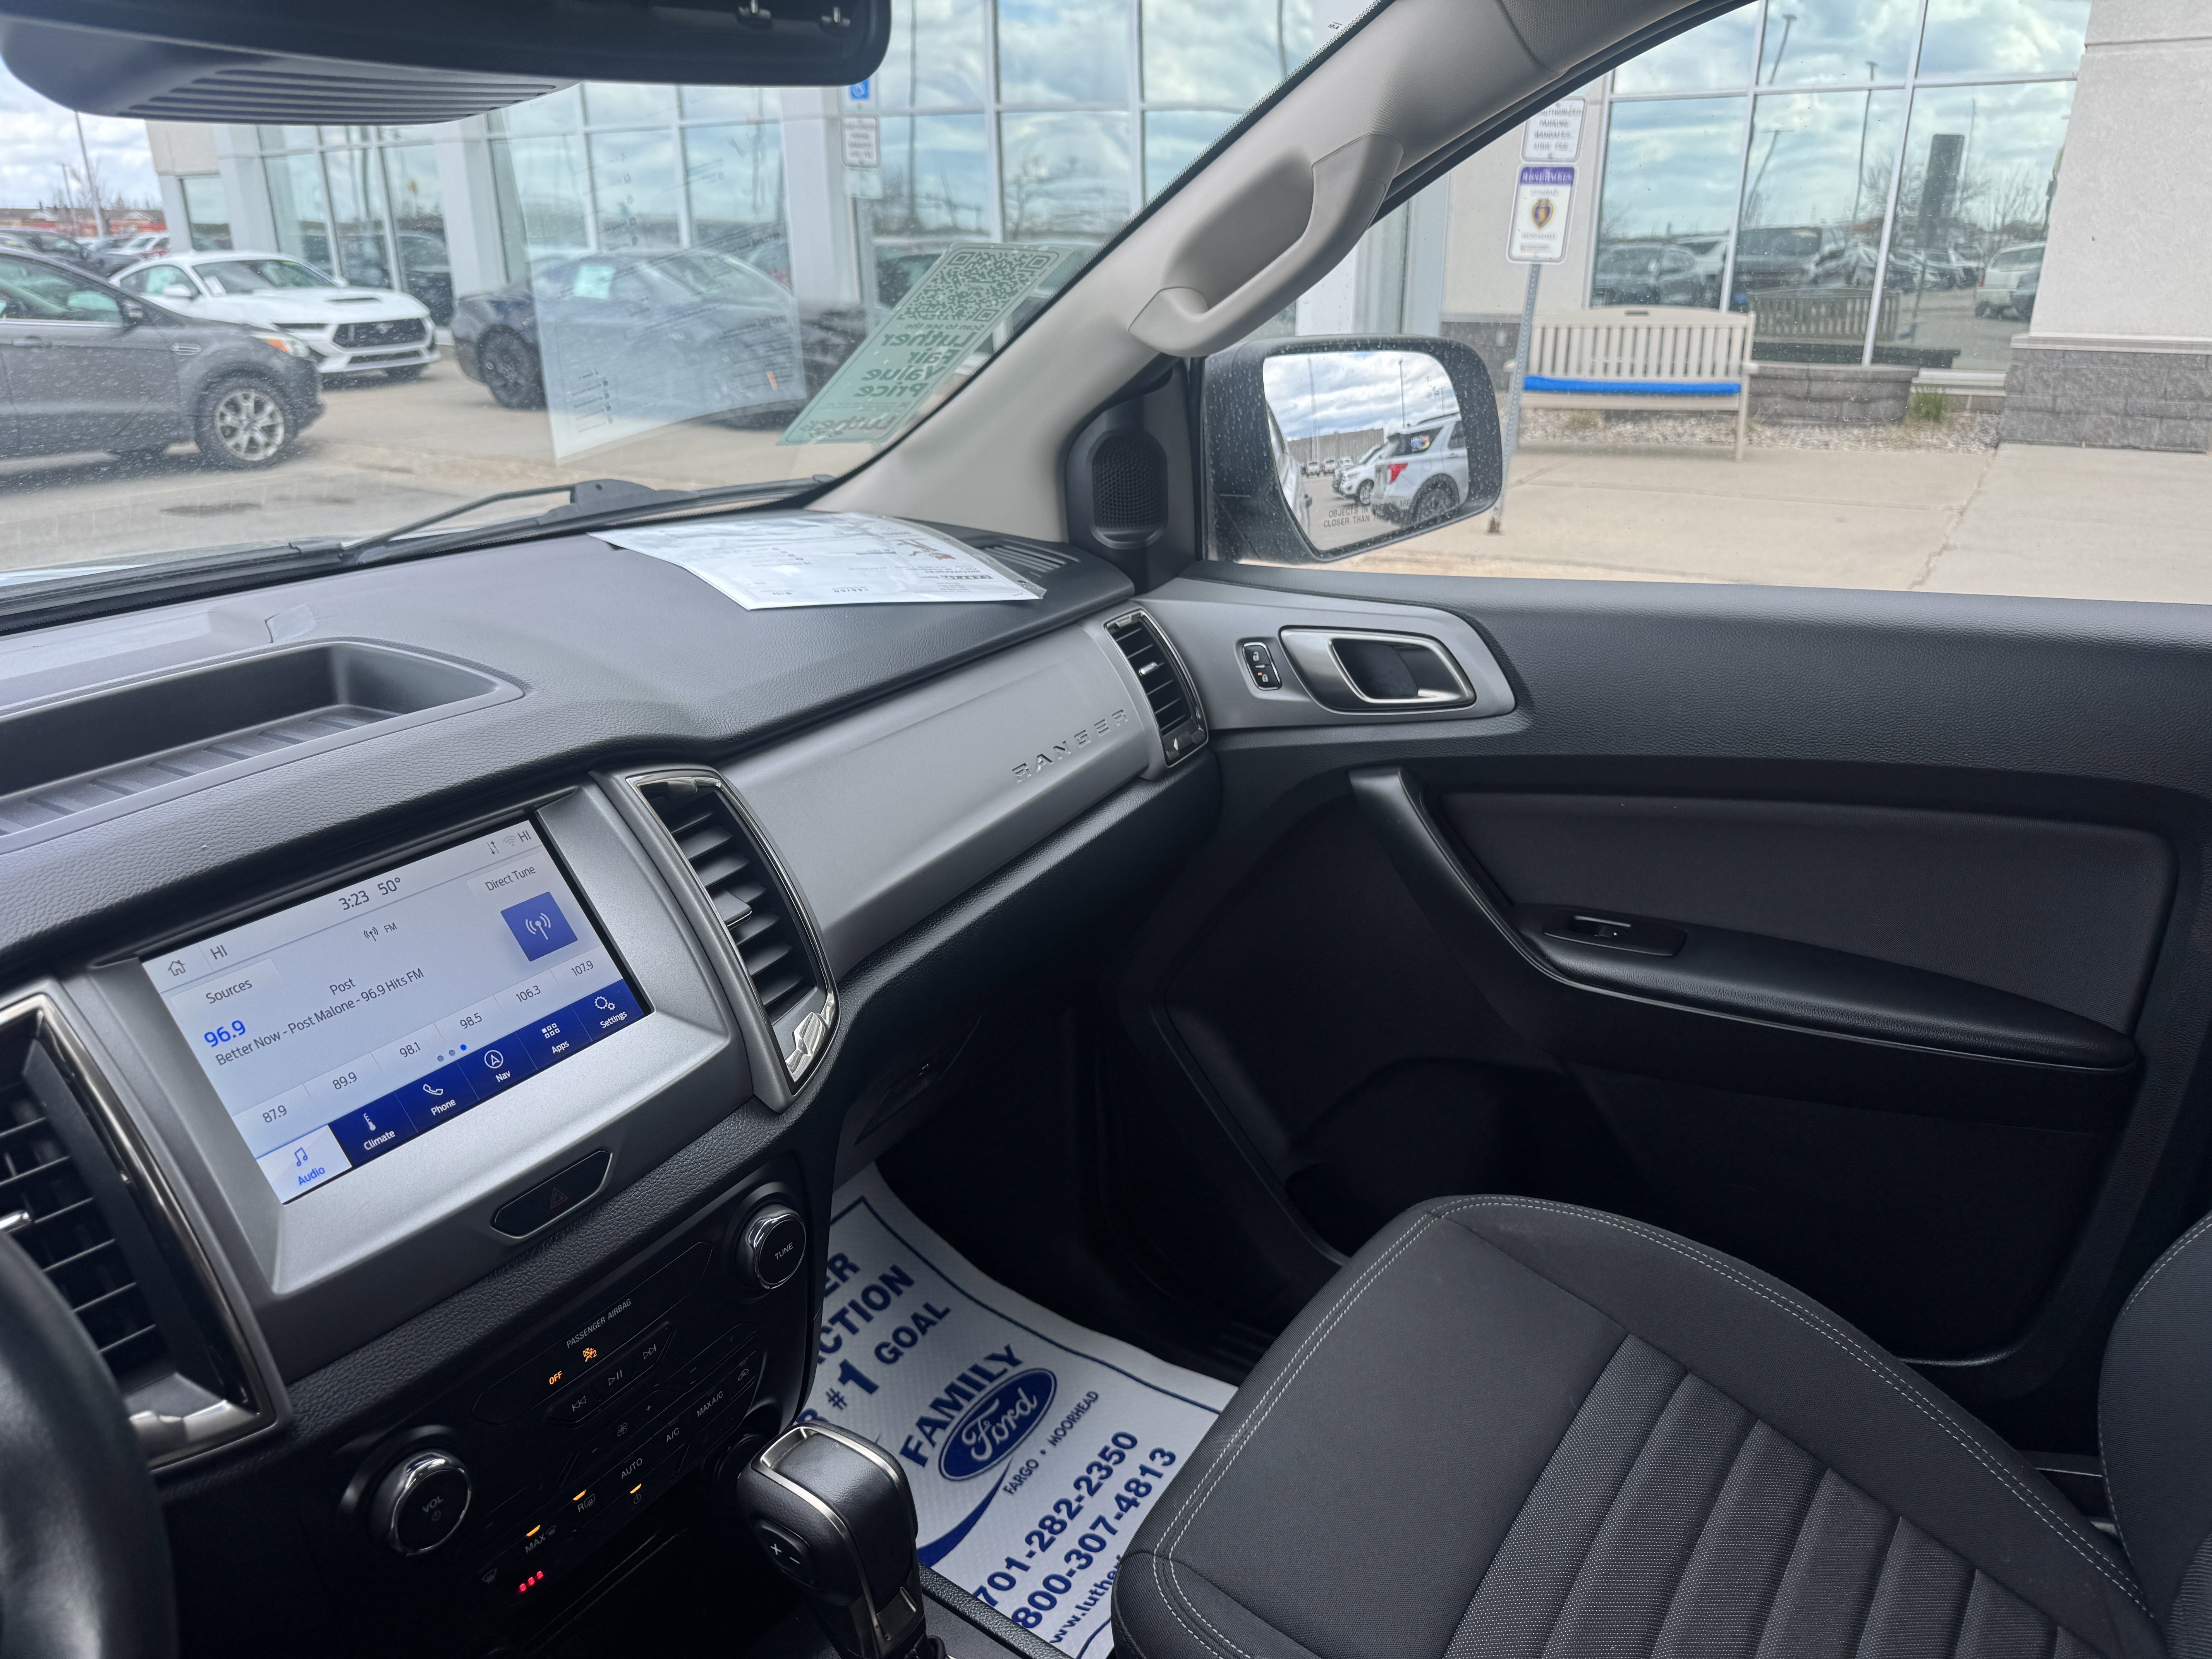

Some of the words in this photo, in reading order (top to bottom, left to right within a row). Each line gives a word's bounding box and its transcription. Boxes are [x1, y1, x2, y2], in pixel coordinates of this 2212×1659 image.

[1328, 505, 1358, 518] OBJECTS
[1323, 517, 1349, 528] CLOSER
[1353, 515, 1370, 524] THAN
[1012, 709, 1128, 783] RANGER
[517, 830, 531, 843] HI
[485, 874, 514, 891] Direct
[512, 865, 536, 880] Tune
[338, 890, 370, 910] 3:23
[377, 877, 401, 896] 50°
[383, 922, 398, 933] FM
[210, 944, 228, 960] HI
[571, 960, 594, 977] 107.9
[206, 979, 252, 1004] Sources
[329, 978, 356, 995] Post
[516, 985, 541, 1003] 106.3
[215, 1044, 253, 1066] Better
[253, 1031, 281, 1049] Now
[288, 1015, 315, 1035] Post
[314, 999, 355, 1023] Malone
[361, 984, 386, 1002] 96.9
[385, 976, 407, 992] Hits
[406, 968, 424, 982] FM
[460, 1012, 483, 1029] 98.5
[600, 1010, 627, 1029] Settings
[204, 1020, 246, 1047] 96.9
[399, 1041, 421, 1058] 98.1
[551, 1040, 570, 1054] Apps
[332, 1072, 357, 1090] 89.9
[495, 1070, 511, 1083] Nav
[262, 1105, 287, 1123] 87.9
[431, 1098, 456, 1116] Phone
[364, 1130, 396, 1151] Climate
[297, 1165, 326, 1185] Audio
[775, 1242, 793, 1260] TUNE
[567, 1317, 606, 1348] PASSENGER
[608, 1298, 631, 1320] AIRBAG
[818, 1264, 915, 1364] CTION
[874, 1302, 951, 1365] GOAL
[549, 1370, 562, 1385] OFF
[899, 1344, 1023, 1468] FAMILY
[962, 1386, 1037, 1461] Ford
[666, 1428, 679, 1443] A/C
[1003, 1459, 1039, 1496] FARGO
[1046, 1391, 1099, 1446] MOORHEAD
[622, 1458, 642, 1479] AUTO
[422, 1496, 444, 1513] VOL
[972, 1431, 1138, 1607] 701-282-2350
[525, 1533, 546, 1554] MAX
[1011, 1447, 1176, 1628] 800-307-4813
